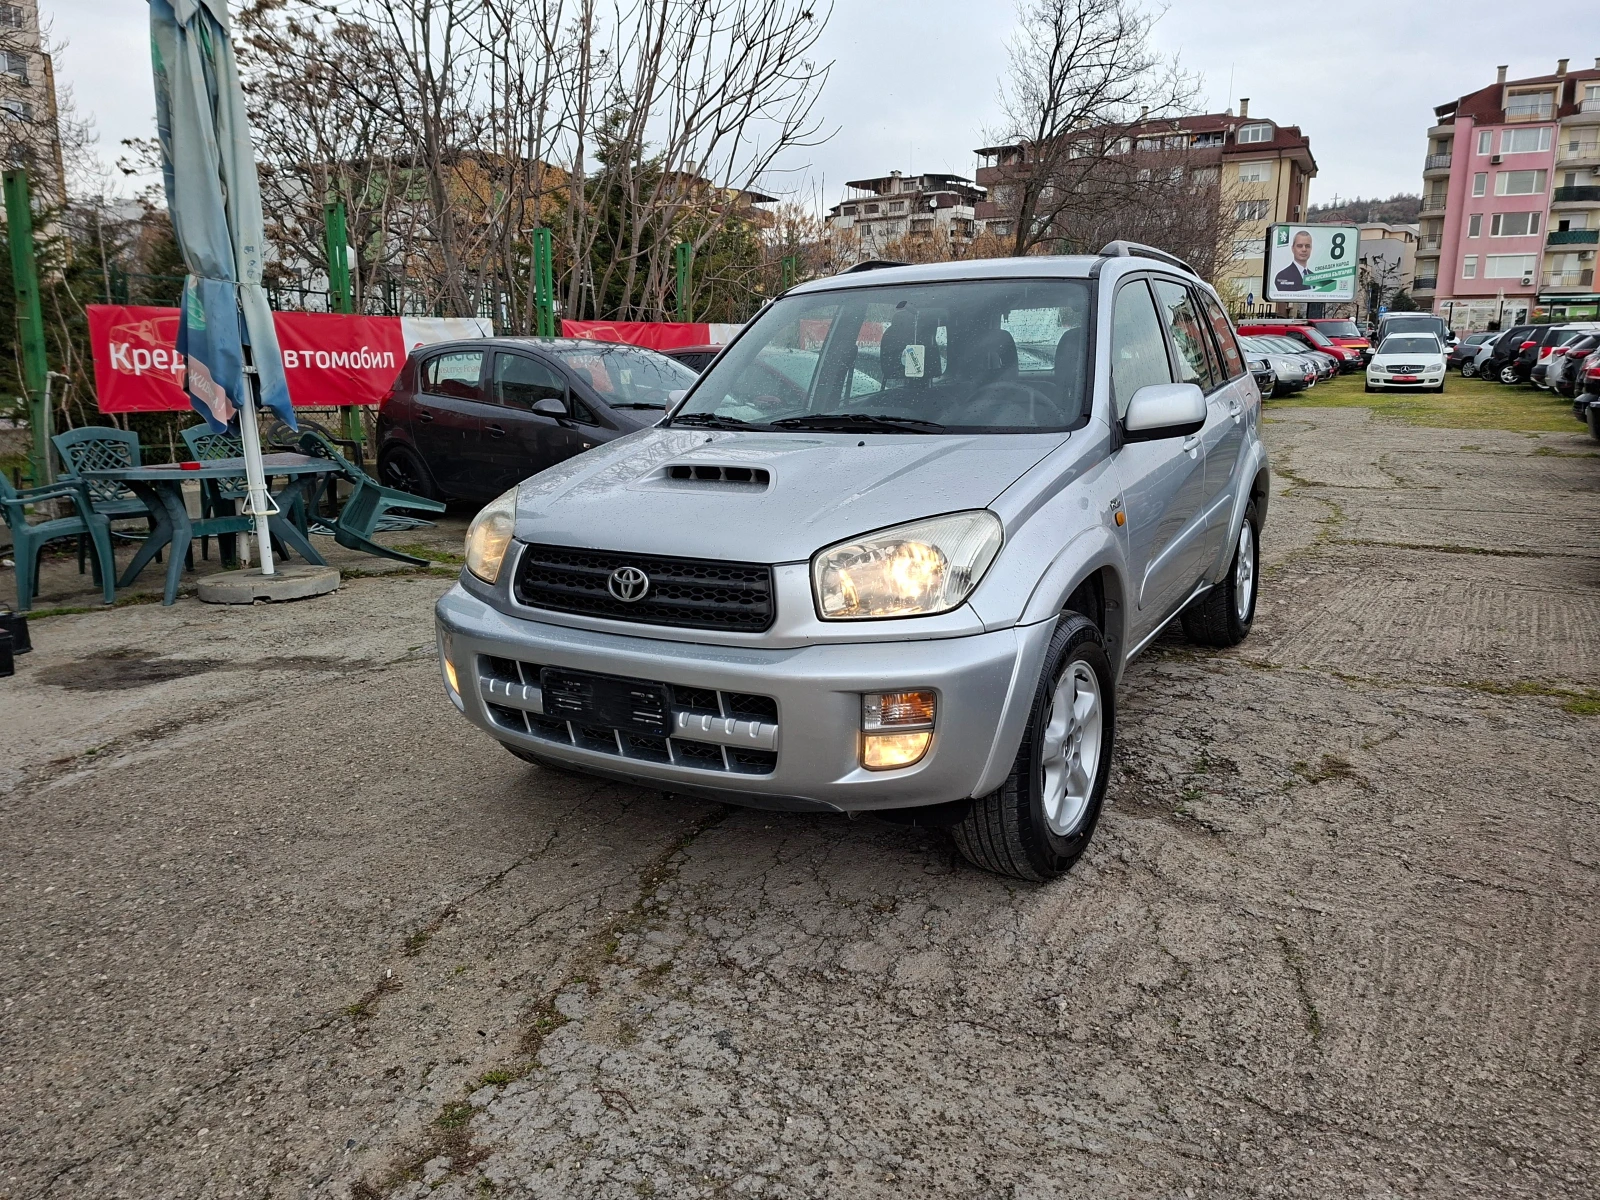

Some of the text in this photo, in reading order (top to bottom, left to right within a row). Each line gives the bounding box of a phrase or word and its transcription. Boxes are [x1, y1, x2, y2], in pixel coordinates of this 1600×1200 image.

[1331, 233, 1346, 260] 8
[109, 342, 395, 376] Кред втомобил
